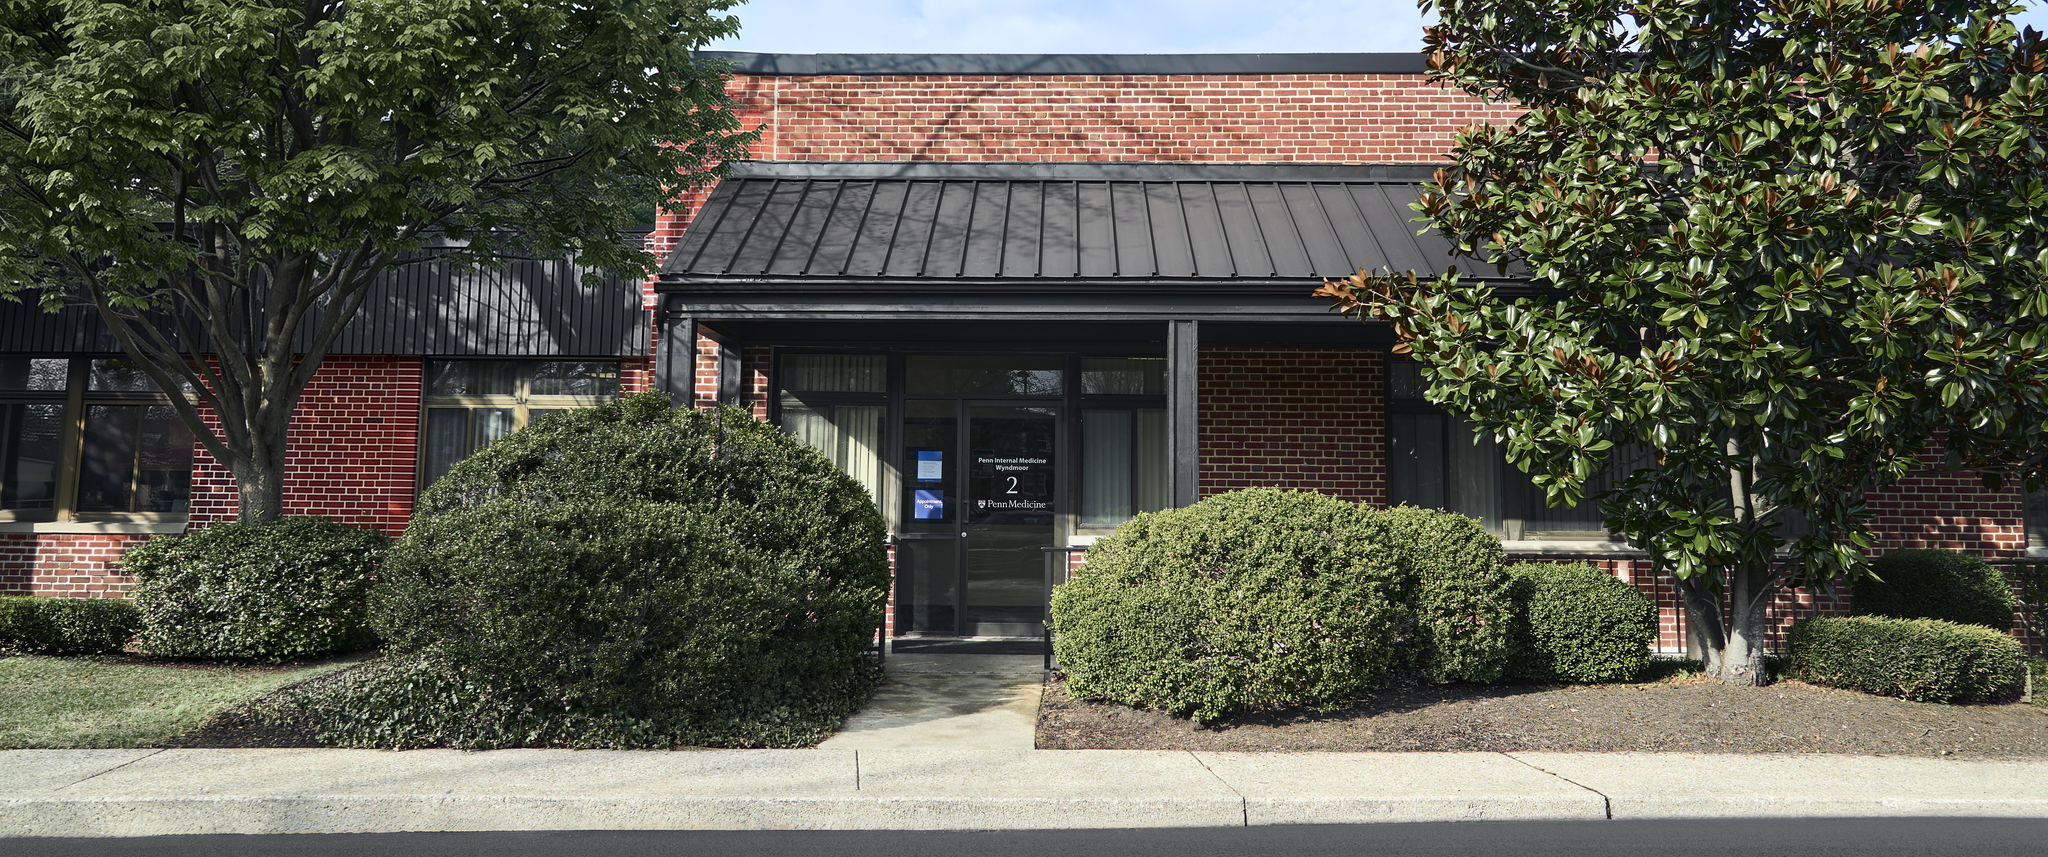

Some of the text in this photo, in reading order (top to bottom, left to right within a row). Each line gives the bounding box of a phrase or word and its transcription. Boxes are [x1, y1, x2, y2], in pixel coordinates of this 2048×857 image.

[995, 464, 1030, 472] Wyndmoor
[1006, 476, 1018, 494] 2
[987, 499, 1046, 508] Penn Medicine
